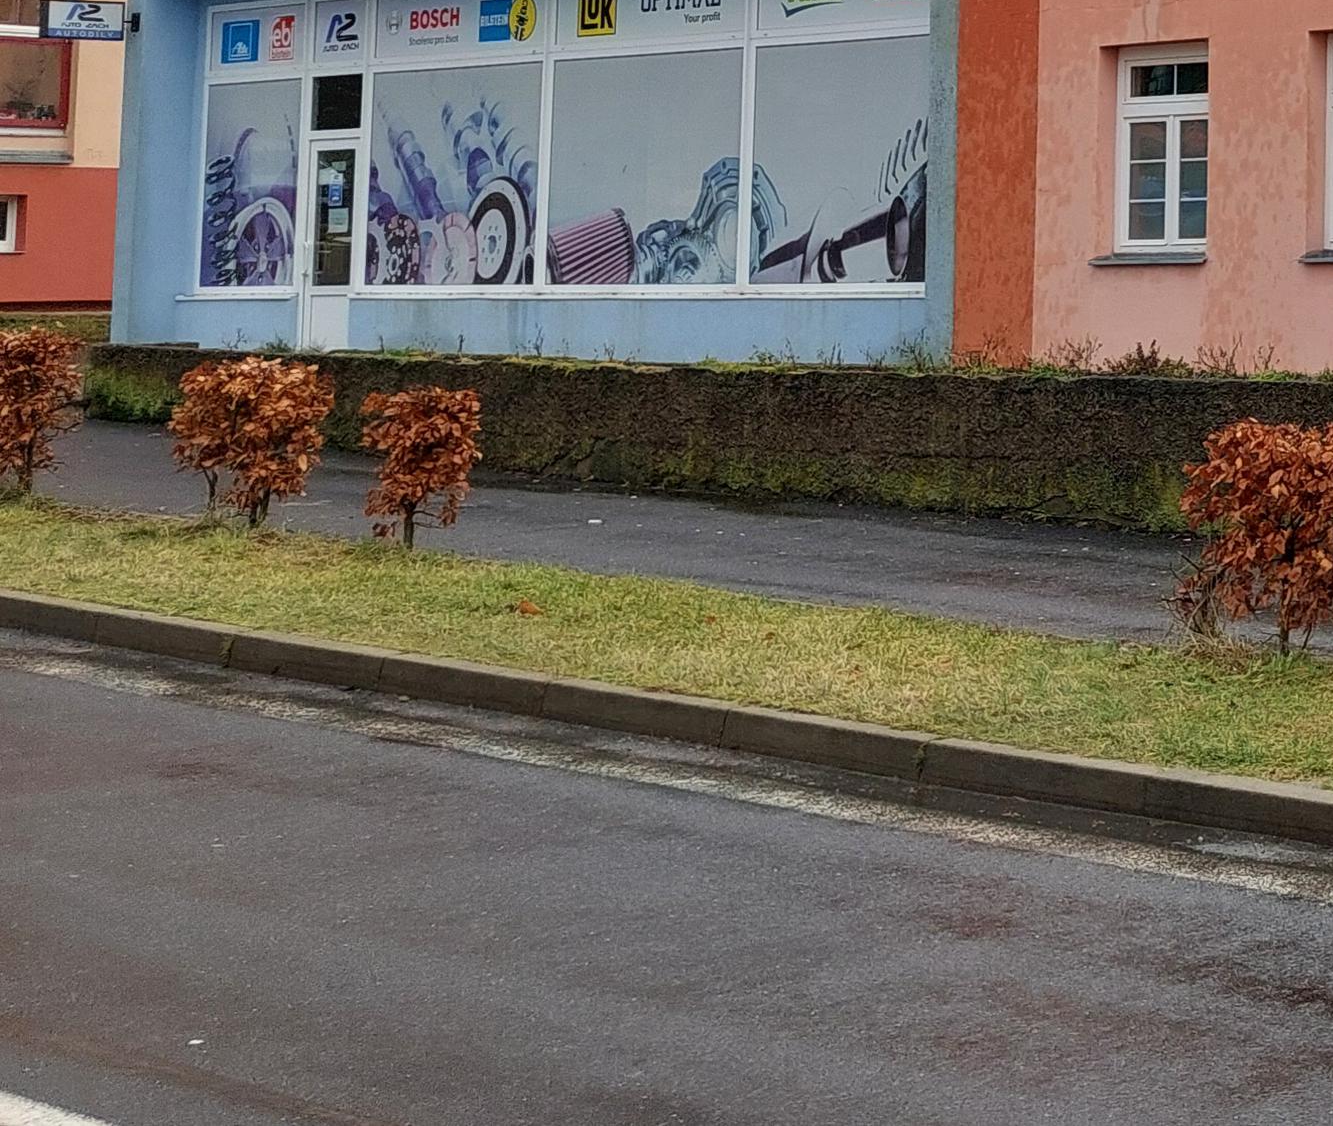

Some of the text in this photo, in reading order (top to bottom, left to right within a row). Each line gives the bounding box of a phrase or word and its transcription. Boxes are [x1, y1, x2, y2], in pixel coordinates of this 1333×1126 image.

[409, 6, 460, 30] BOSCH
[683, 11, 721, 24] Your profit
